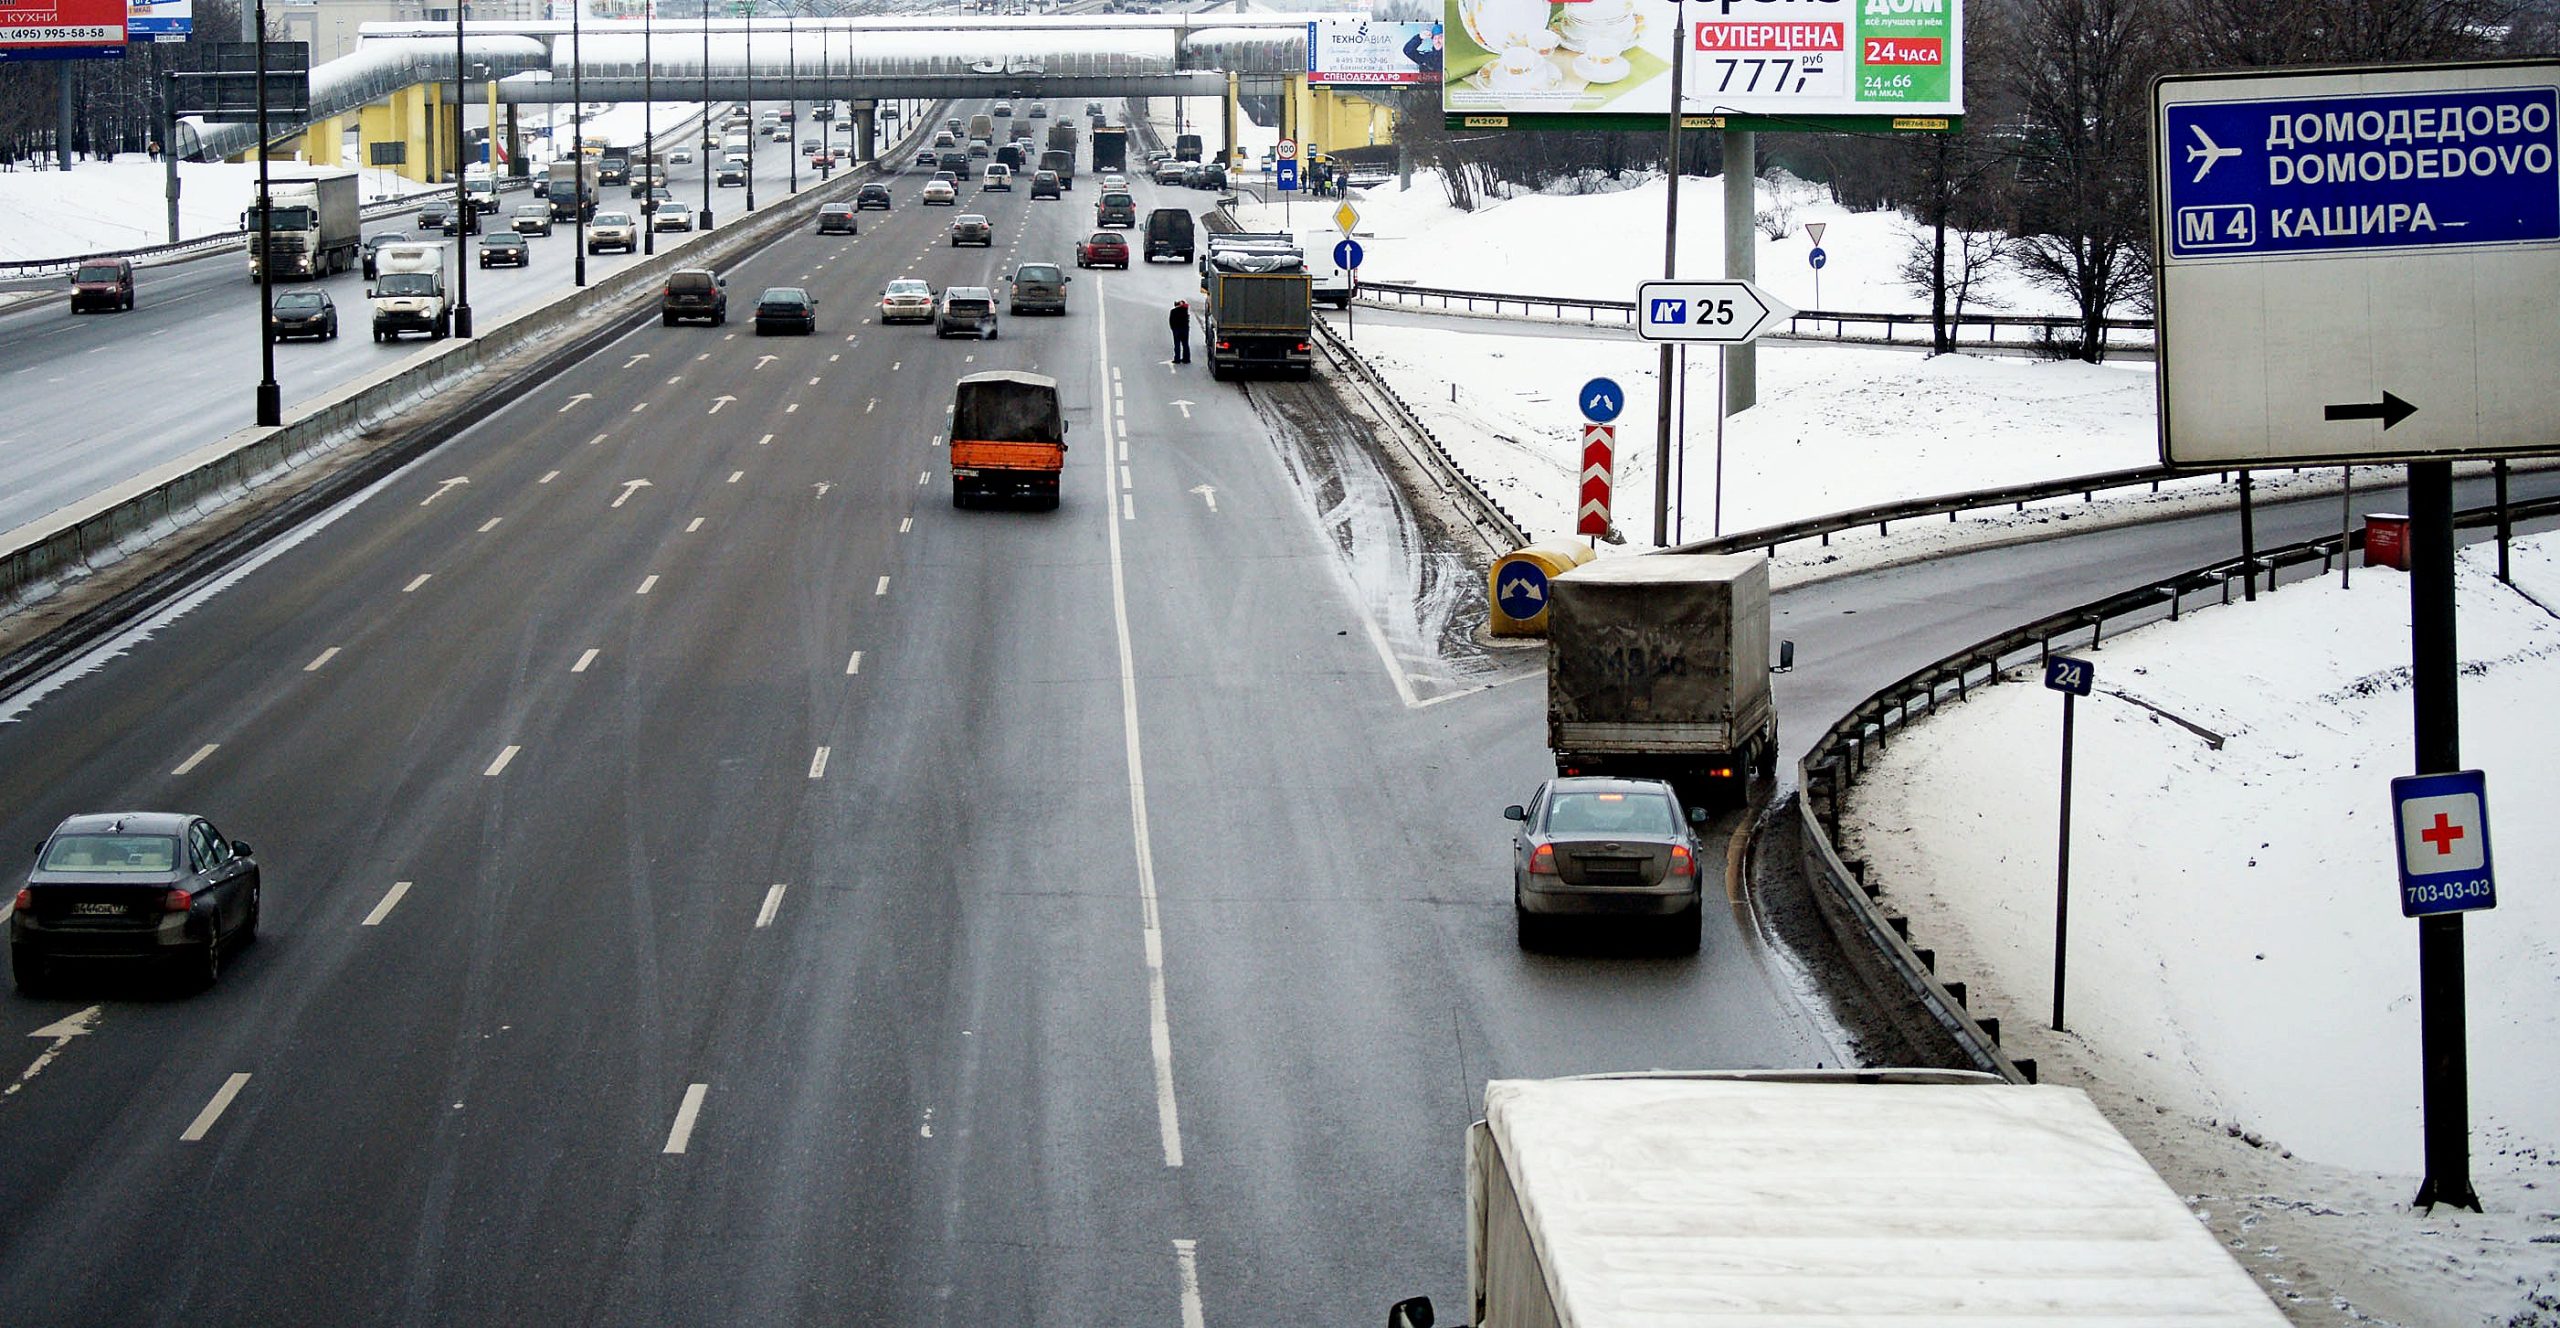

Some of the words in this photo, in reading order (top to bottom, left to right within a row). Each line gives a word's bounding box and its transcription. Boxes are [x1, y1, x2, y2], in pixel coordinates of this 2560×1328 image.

[7, 13, 58, 22] КУХНИ
[1865, 17, 1880, 26] всё
[1881, 18, 1915, 28] лучшее
[1925, 17, 1943, 26] нём
[11, 29, 41, 39] (495)
[44, 28, 104, 38] 995-58-58
[1700, 26, 1838, 50] СУПЕРЦЕНА
[1802, 53, 1823, 66] руб
[1867, 41, 1896, 61] 24
[1899, 49, 1938, 61] ЧАСА
[1324, 72, 1400, 81] СПЕЦОДЕЖДА.РФ
[1864, 76, 1881, 89] 24
[1892, 74, 1911, 87] 66
[2266, 103, 2551, 150] ДОМОДЕДОВО
[1280, 145, 1294, 153] 100
[2269, 143, 2552, 185] DOMODEDOVO
[2185, 212, 2214, 242] М
[2226, 210, 2248, 240] 4
[2272, 202, 2437, 239] КАШИРА
[1696, 299, 1734, 325] 25
[2055, 663, 2081, 688] 24
[2407, 879, 2490, 904] 703-03-03
